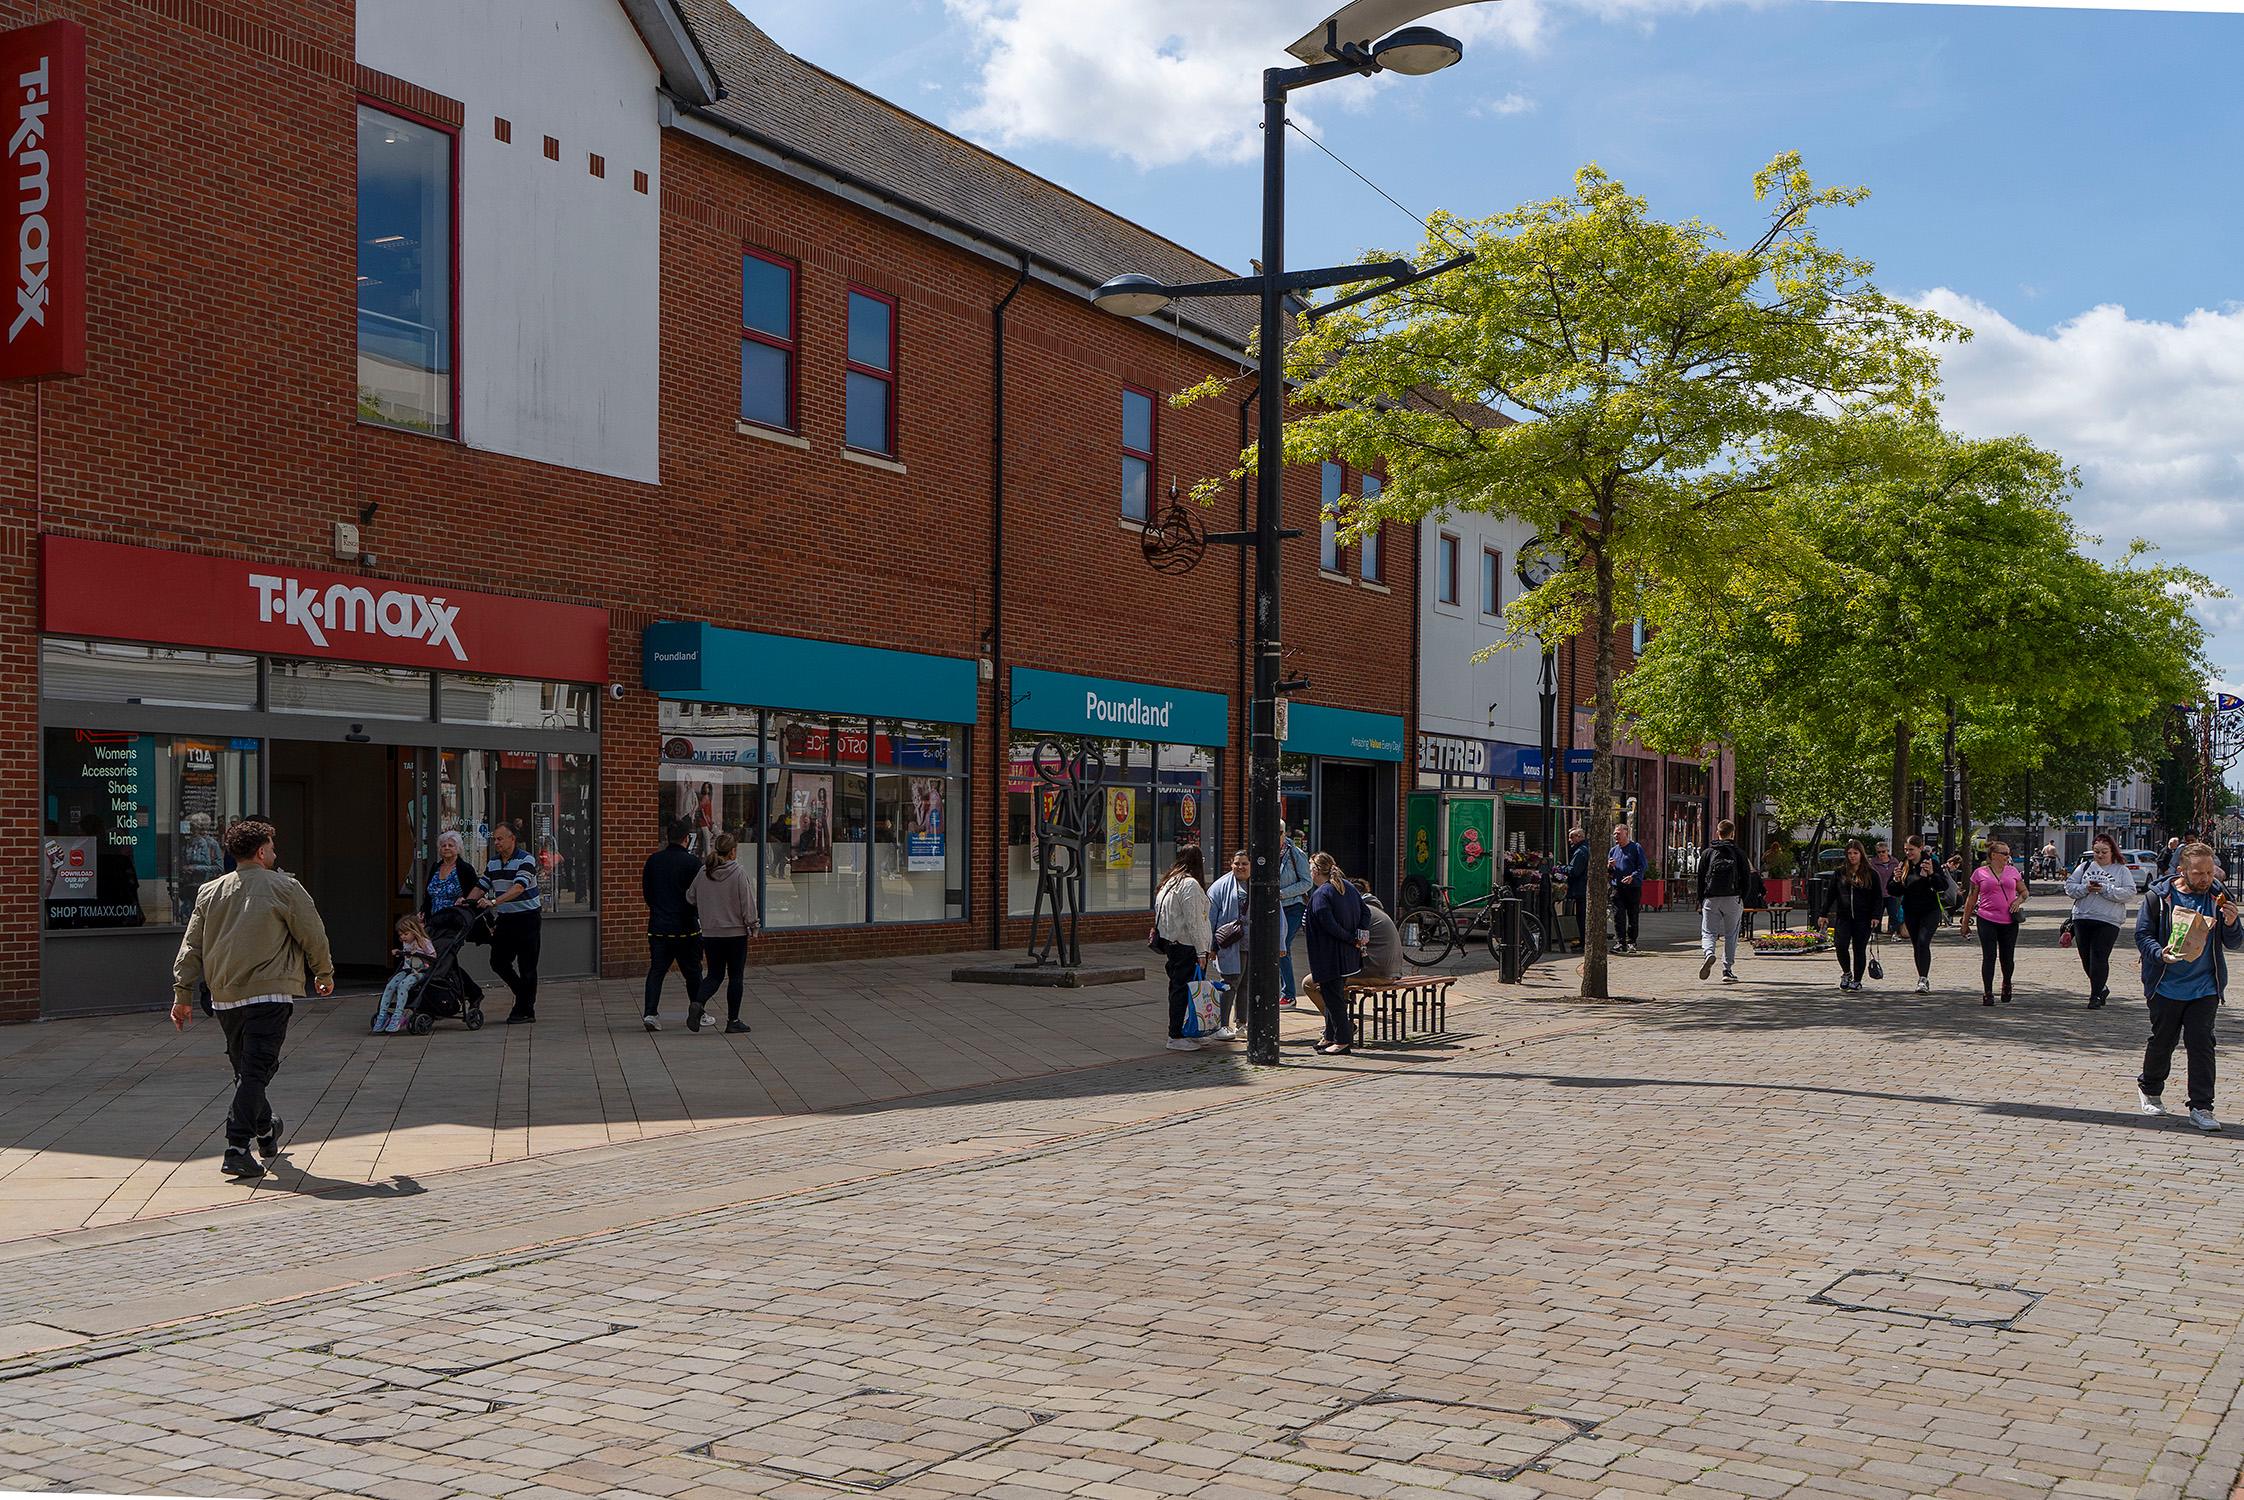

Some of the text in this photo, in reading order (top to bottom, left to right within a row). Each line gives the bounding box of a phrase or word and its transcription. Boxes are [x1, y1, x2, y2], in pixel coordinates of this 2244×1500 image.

[654, 650, 697, 661] Poundland
[1086, 692, 1169, 728] Poundland
[1350, 737, 1370, 751] Amazing
[94, 746, 137, 760] Womens
[1418, 736, 1484, 773] BETFRED
[82, 763, 138, 777] Accessories
[1523, 762, 1541, 777] bonus
[108, 781, 138, 794] Shoes
[111, 797, 138, 811] Mens
[116, 815, 138, 829] Kids
[109, 832, 138, 846] Home
[50, 905, 137, 918] SHOP TKMAXX.COM
